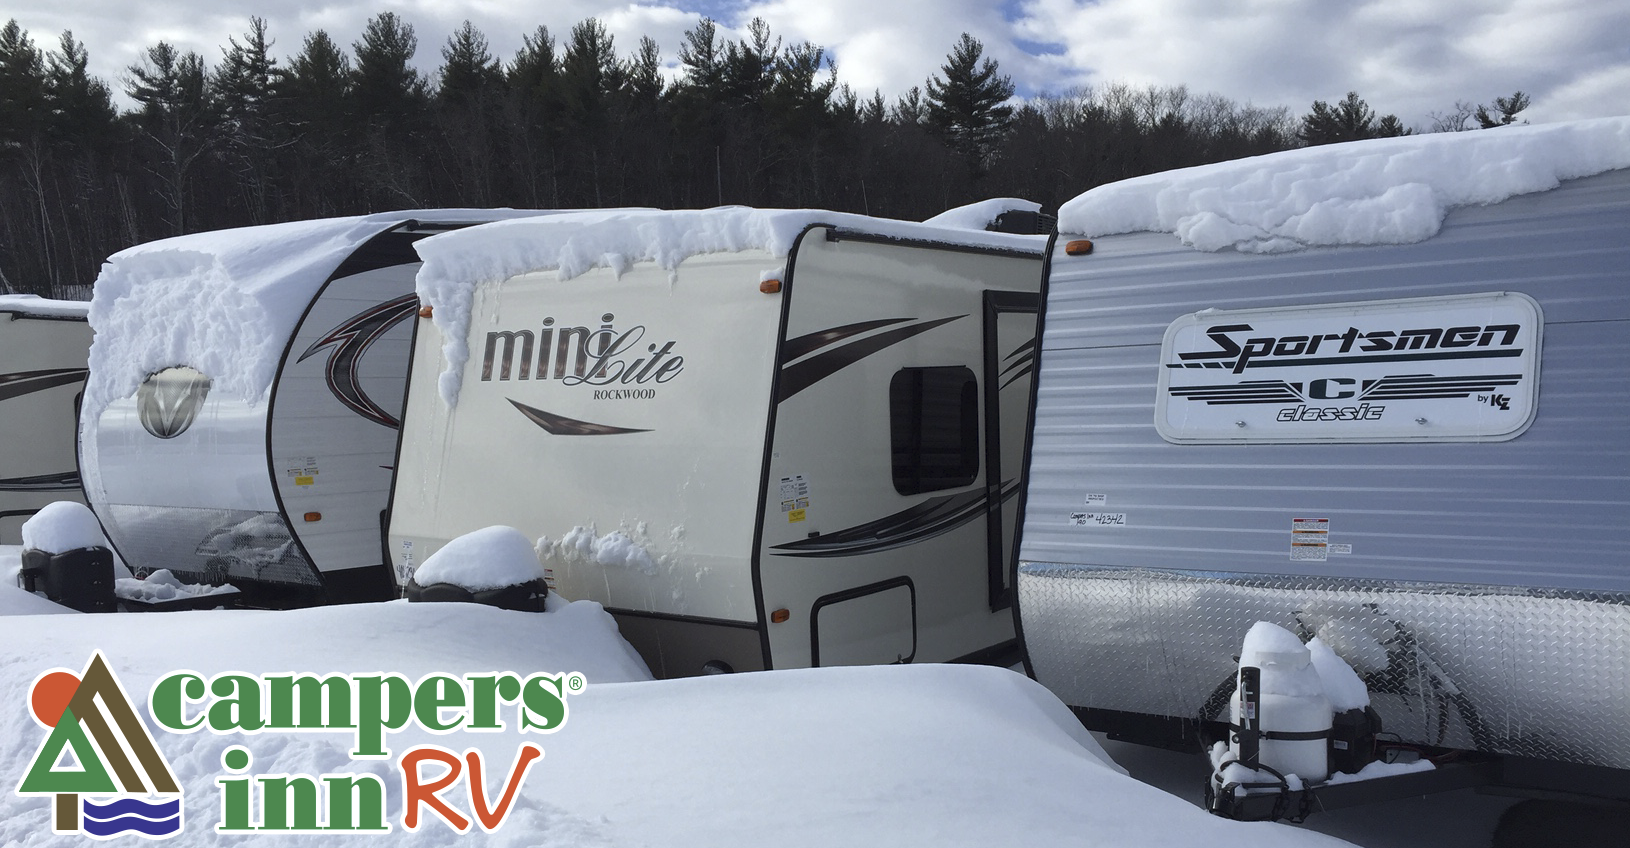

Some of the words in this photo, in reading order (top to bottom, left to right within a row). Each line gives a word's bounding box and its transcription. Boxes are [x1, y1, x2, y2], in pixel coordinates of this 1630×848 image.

[481, 313, 614, 382] mini
[562, 325, 684, 386] Lite
[1178, 323, 1521, 374] Sportsmen
[593, 388, 656, 400] ROCKWOOD
[1477, 394, 1489, 404] by
[1490, 393, 1511, 411] KZ
[1276, 403, 1386, 423] classic
[1095, 512, 1124, 525] 42342
